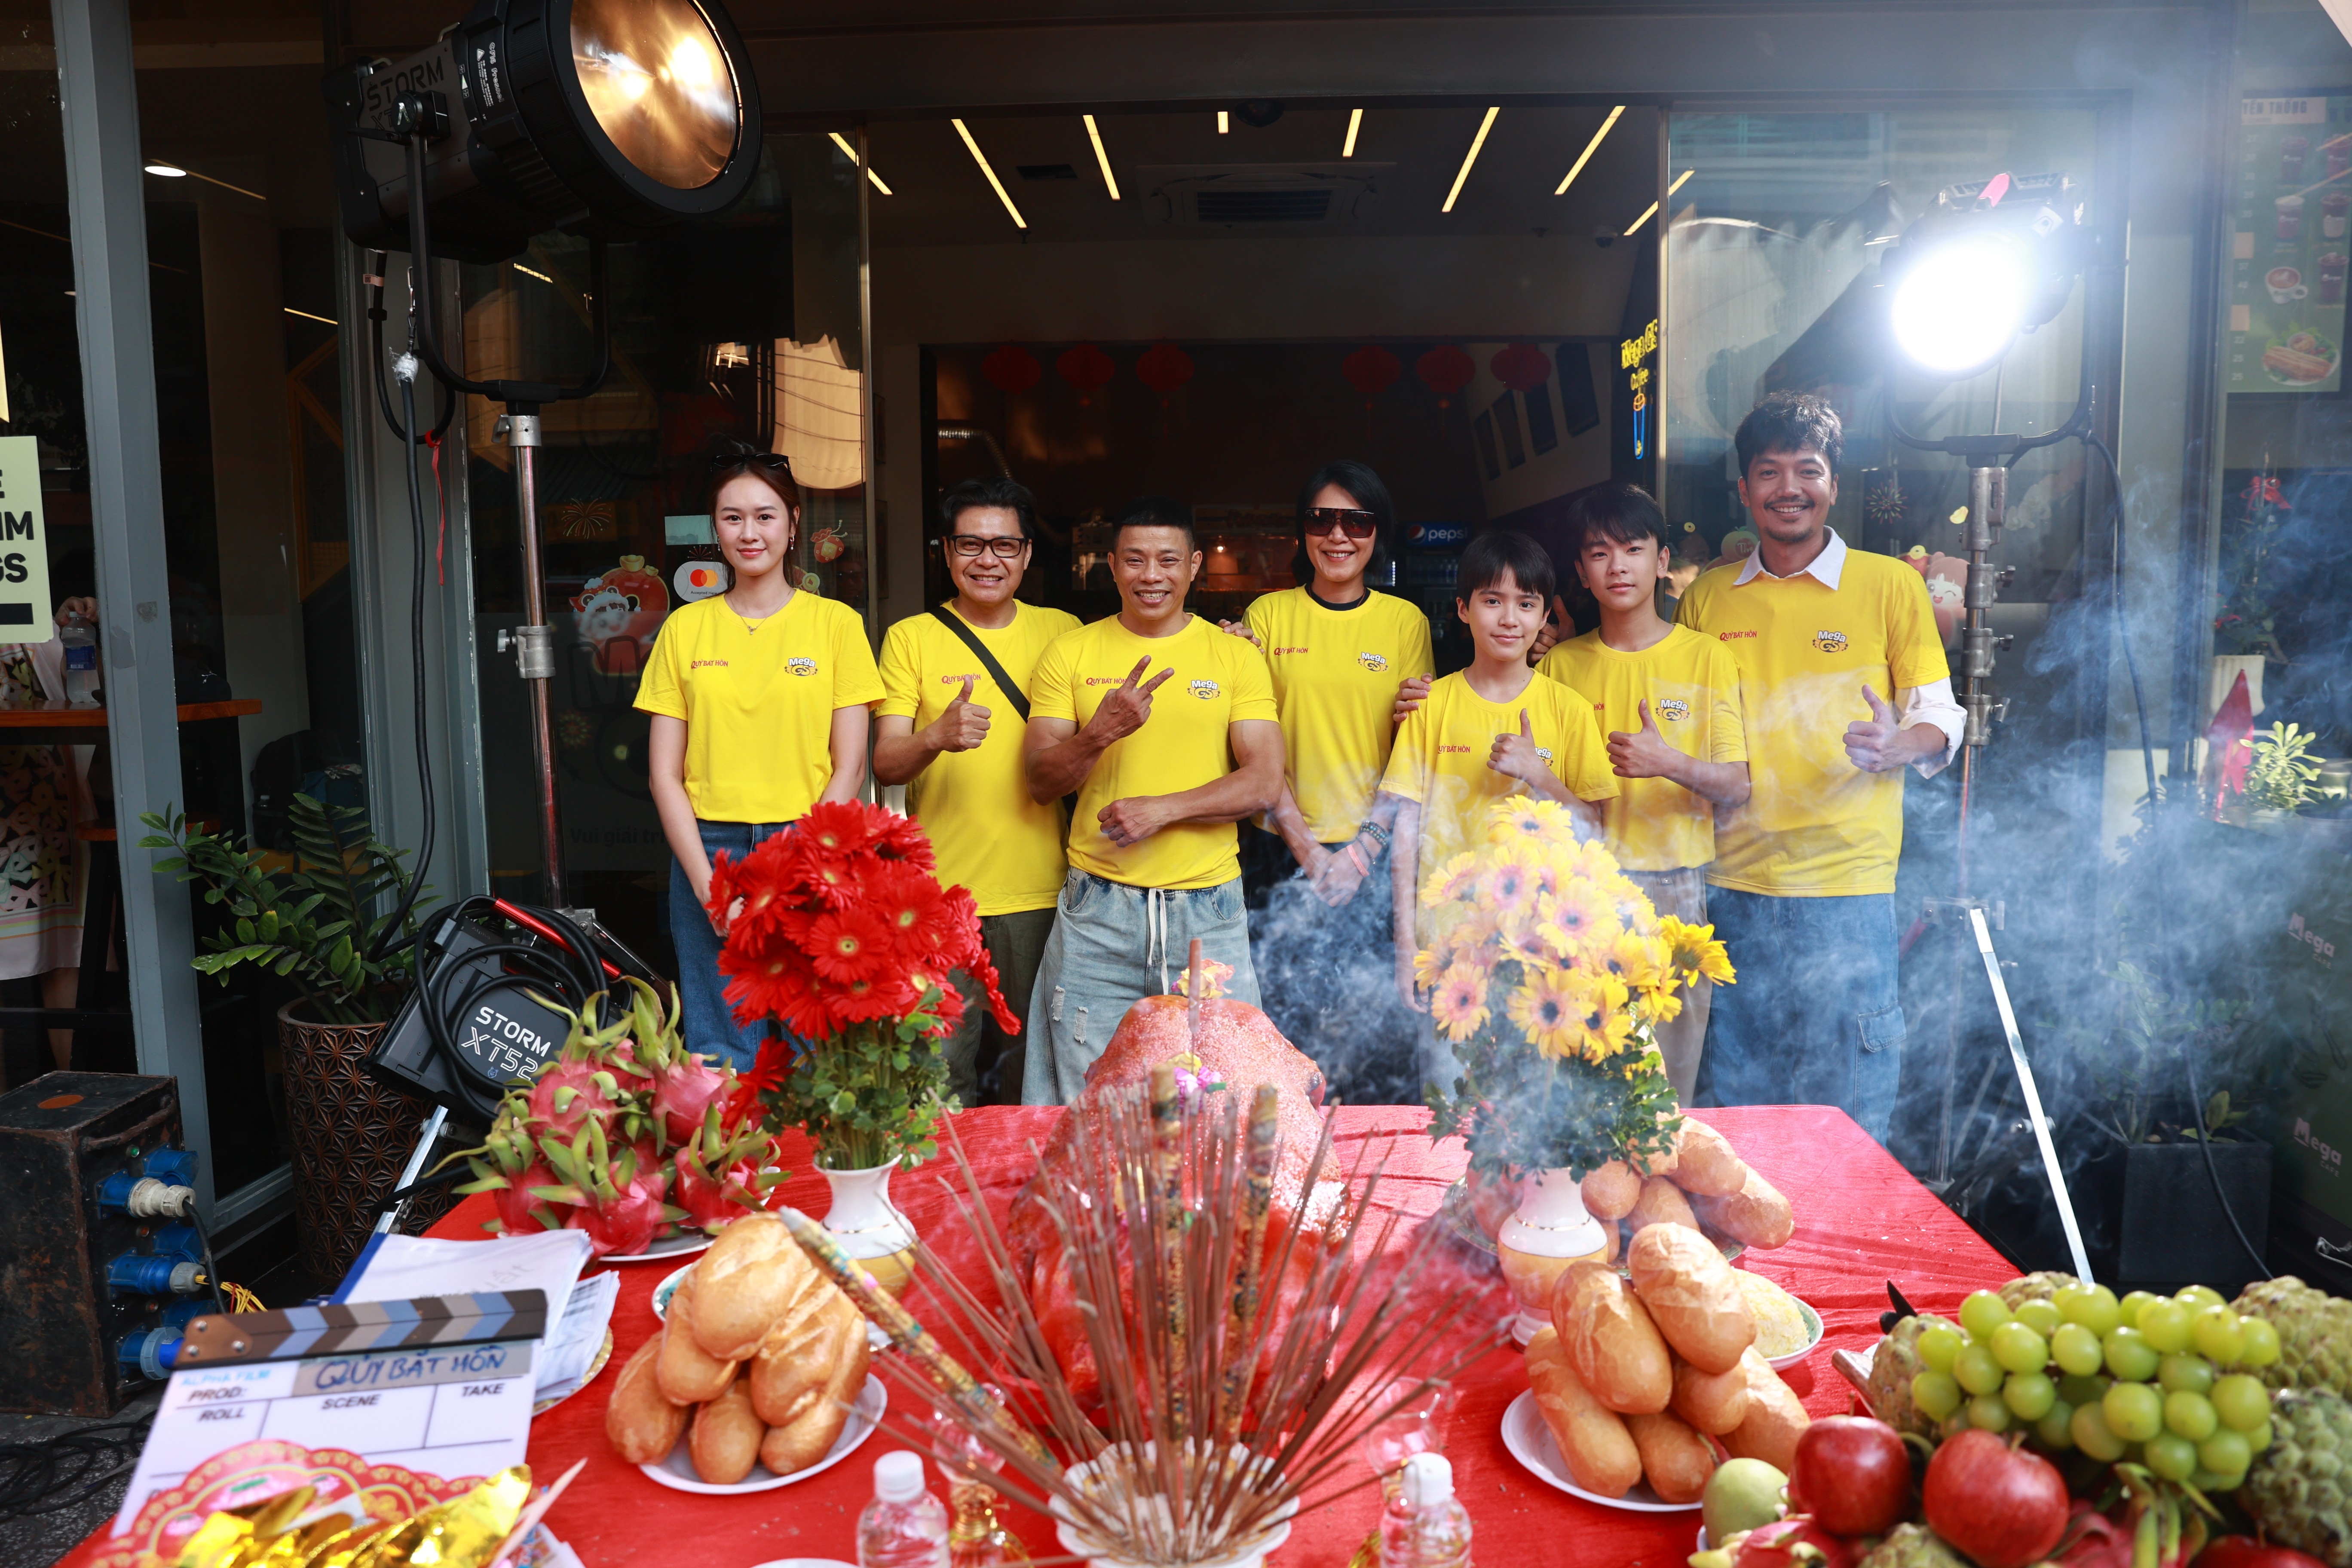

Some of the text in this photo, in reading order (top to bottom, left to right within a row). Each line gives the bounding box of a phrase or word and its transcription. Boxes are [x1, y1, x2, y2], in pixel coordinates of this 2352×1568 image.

[367, 56, 444, 112] STORM
[491, 67, 505, 103] Fresnel
[1428, 527, 1468, 542] pepsi
[1818, 630, 1847, 643] Mega
[1819, 640, 1840, 652] GS
[789, 657, 815, 667] Mega
[1361, 651, 1386, 664] Mega
[791, 665, 810, 676] GS
[1364, 660, 1381, 671] GS
[1191, 680, 1218, 690] Mega
[1194, 688, 1213, 700] GS
[1660, 698, 1688, 711] Mega
[1662, 708, 1682, 721] GS
[2287, 912, 2335, 958] Mega
[475, 1006, 551, 1057] STORM
[461, 1026, 538, 1081] XT52
[2294, 1117, 2342, 1166] Mega
[235, 1369, 271, 1382] FILM
[187, 1387, 248, 1402] PROD:
[461, 1383, 505, 1397] TAKE
[322, 1394, 381, 1410] SCENE
[198, 1407, 245, 1421] ROLL
